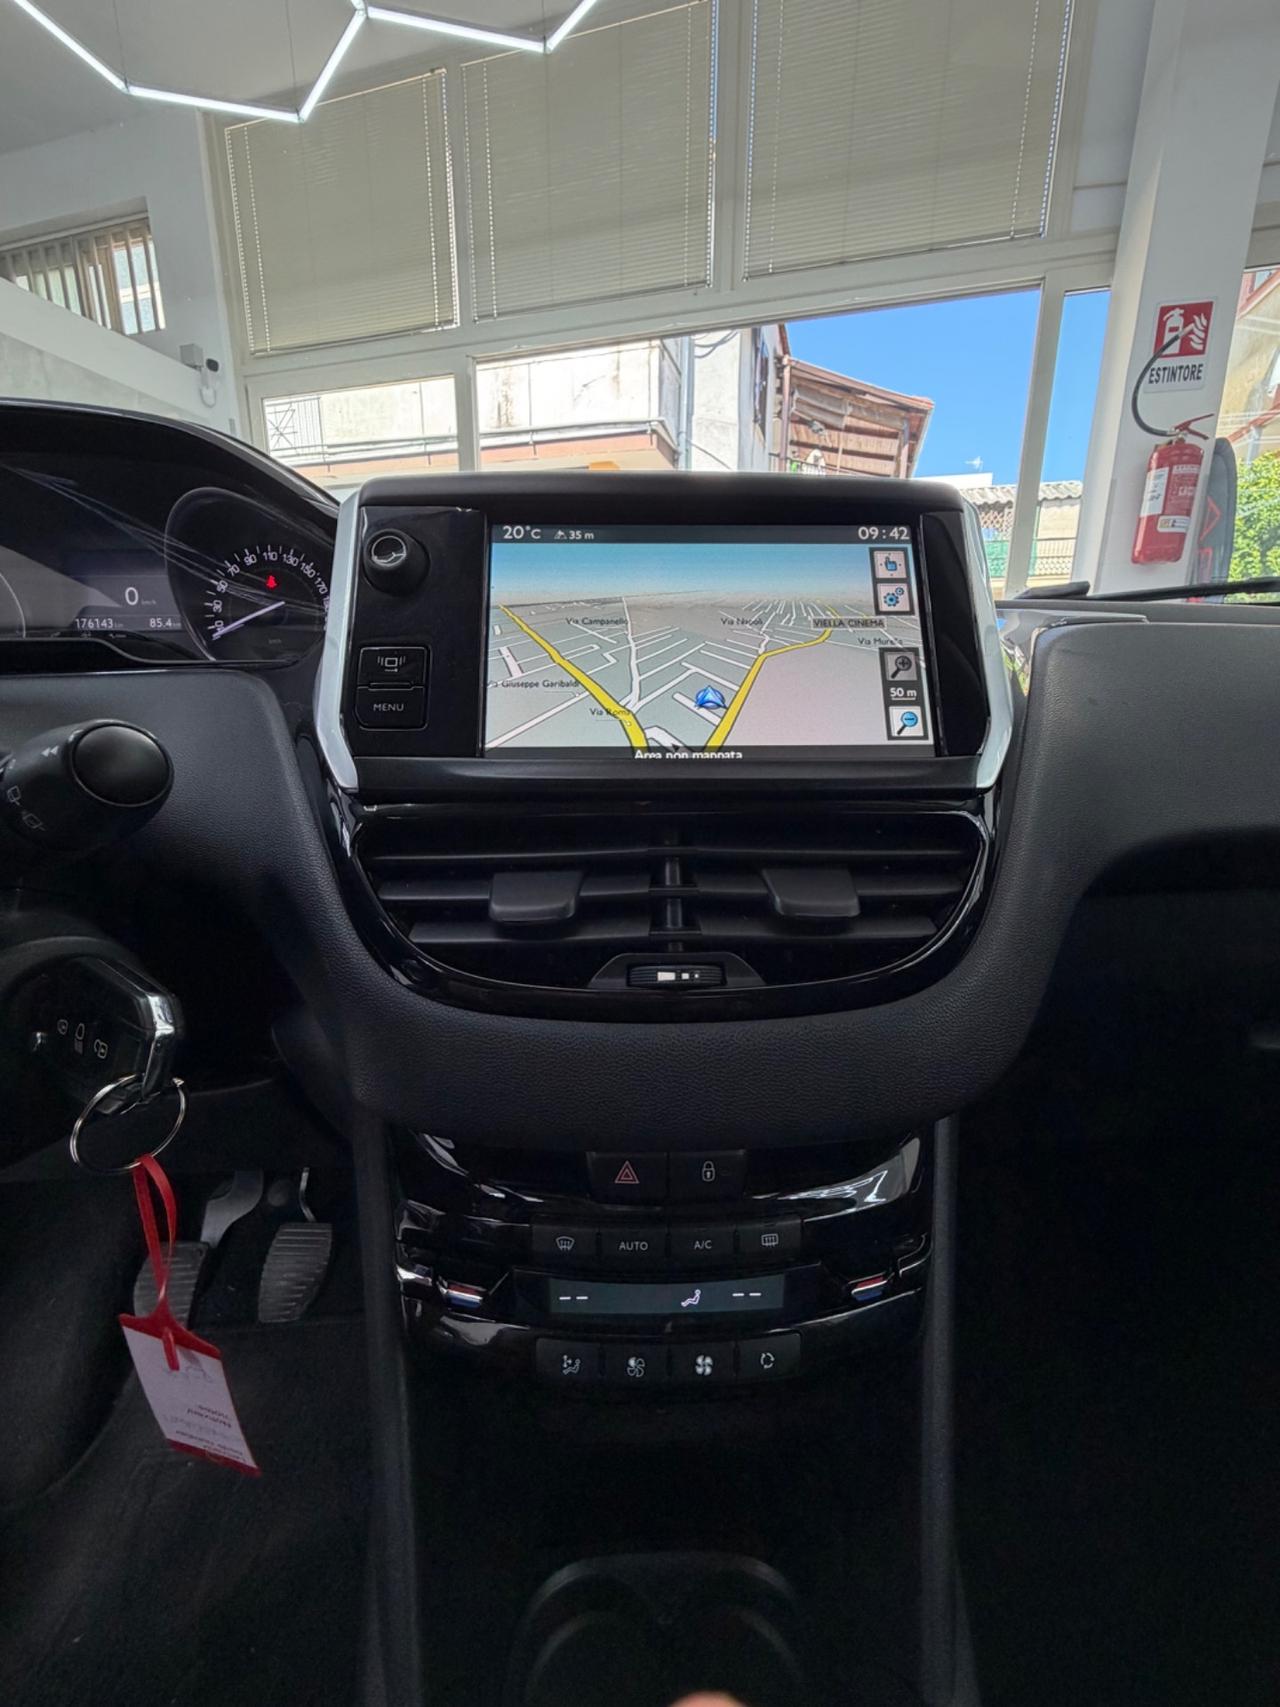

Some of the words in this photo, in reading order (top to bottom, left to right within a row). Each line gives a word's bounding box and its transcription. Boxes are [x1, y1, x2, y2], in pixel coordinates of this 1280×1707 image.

[1148, 363, 1204, 385] ESTINTORE
[502, 525, 542, 540] 20°C
[568, 530, 583, 540] 35
[584, 532, 596, 540] m
[857, 526, 911, 541] 09:42
[243, 553, 258, 567] 90
[262, 551, 278, 561] 110
[282, 553, 300, 567] 130
[226, 564, 241, 577] 70
[300, 562, 317, 578] 150
[313, 577, 329, 595] 170
[124, 587, 139, 606] 0
[75, 617, 114, 629] 176143
[149, 617, 173, 629] 85.4
[565, 617, 579, 625] Via
[847, 618, 886, 628] CINEMA
[857, 637, 872, 645] Via
[501, 679, 540, 689] Giuseppe
[890, 687, 905, 697] 50
[906, 689, 918, 697] m
[372, 703, 405, 712] MENU
[589, 707, 604, 716] Via
[634, 749, 662, 759] Area
[665, 751, 689, 759] non
[618, 1241, 649, 1251] AUTO
[693, 1239, 713, 1250] A/C
